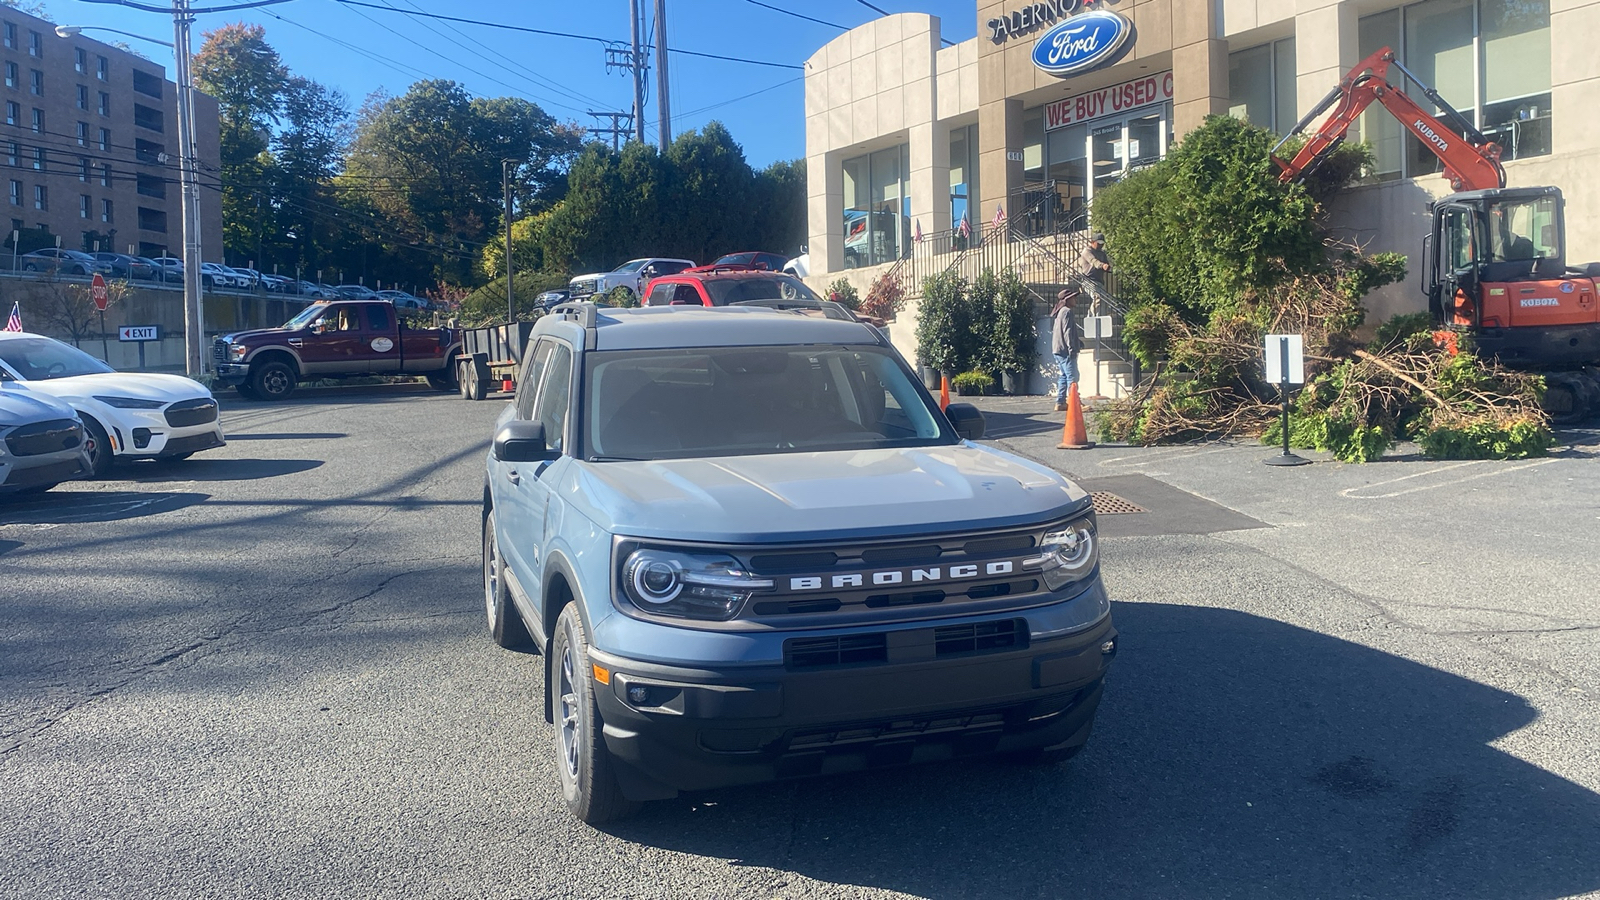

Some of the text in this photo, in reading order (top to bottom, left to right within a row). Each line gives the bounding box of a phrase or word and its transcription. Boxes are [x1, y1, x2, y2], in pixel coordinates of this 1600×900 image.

[986, 0, 1077, 39] SALERNO
[1048, 25, 1100, 64] Ford
[1047, 100, 1071, 127] WE
[1076, 90, 1107, 120] BUY
[1112, 78, 1157, 111] USED
[1413, 119, 1449, 152] KUBOTA
[93, 285, 106, 299] STOP
[1521, 298, 1559, 307] KUBOTA
[132, 328, 153, 338] EXIT
[790, 561, 1013, 590] BRONCO
